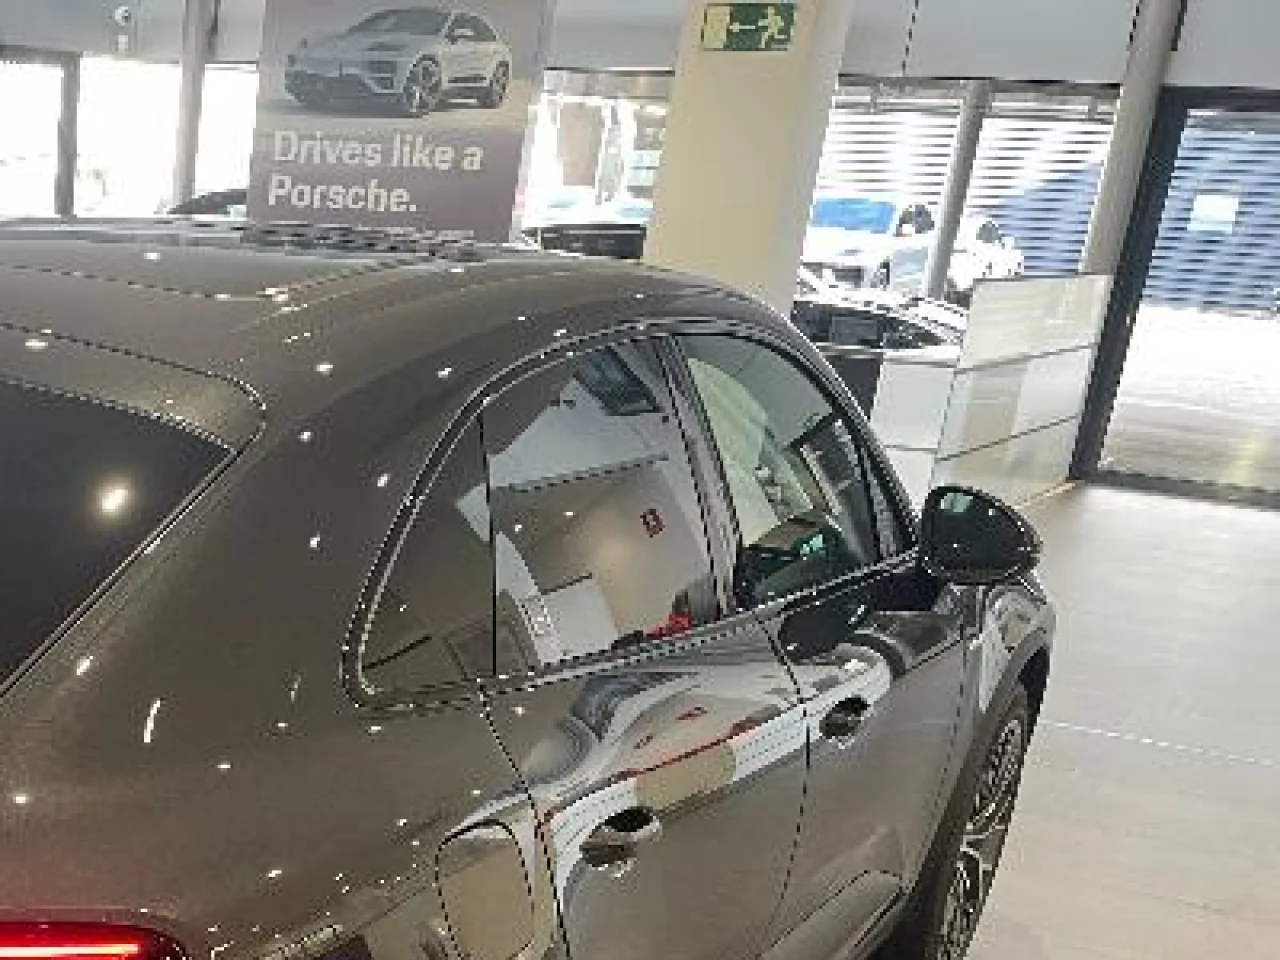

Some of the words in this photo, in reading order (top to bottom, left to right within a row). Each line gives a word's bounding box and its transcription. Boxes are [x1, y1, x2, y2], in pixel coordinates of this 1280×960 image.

[273, 130, 383, 167] Drives
[391, 133, 455, 172] like
[460, 144, 483, 172] a
[268, 175, 417, 212] Porsche.
